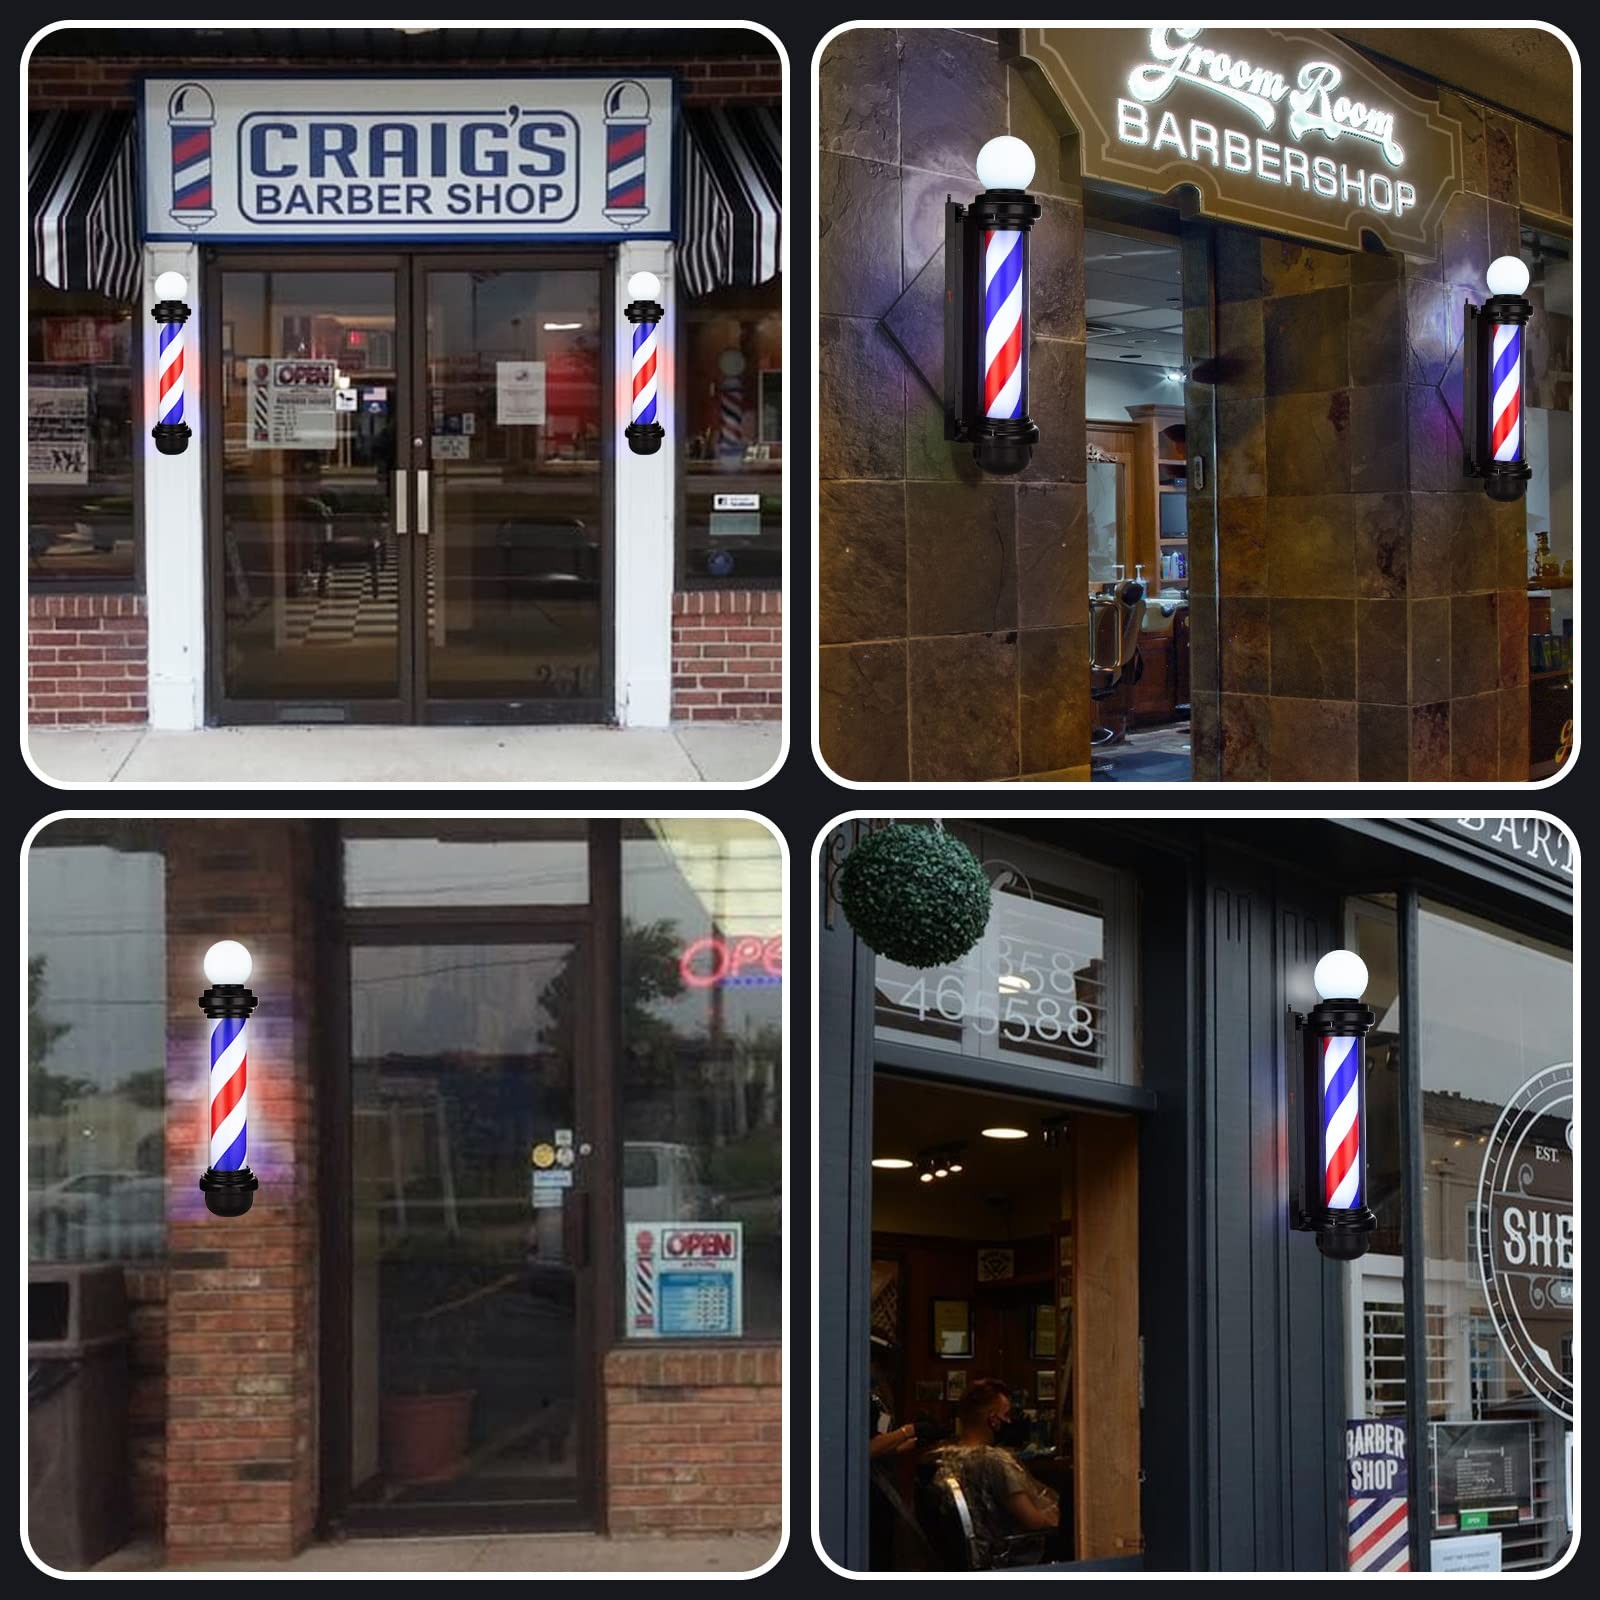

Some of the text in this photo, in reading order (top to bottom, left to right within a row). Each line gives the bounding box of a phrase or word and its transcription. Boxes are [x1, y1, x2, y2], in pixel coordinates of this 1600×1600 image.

[1127, 28, 1406, 168] Groom Room
[250, 104, 567, 178] CRAIG'S
[1117, 97, 1417, 217] BARBERSHOP
[255, 183, 564, 215] BARBER SHOP
[278, 364, 331, 385] OPEN
[900, 975, 1094, 1047] 465588
[1535, 1145, 1560, 1163] EST.
[666, 1232, 732, 1256] OPEN
[1346, 1423, 1405, 1460] BARBER
[1351, 1459, 1398, 1491] SHOP
